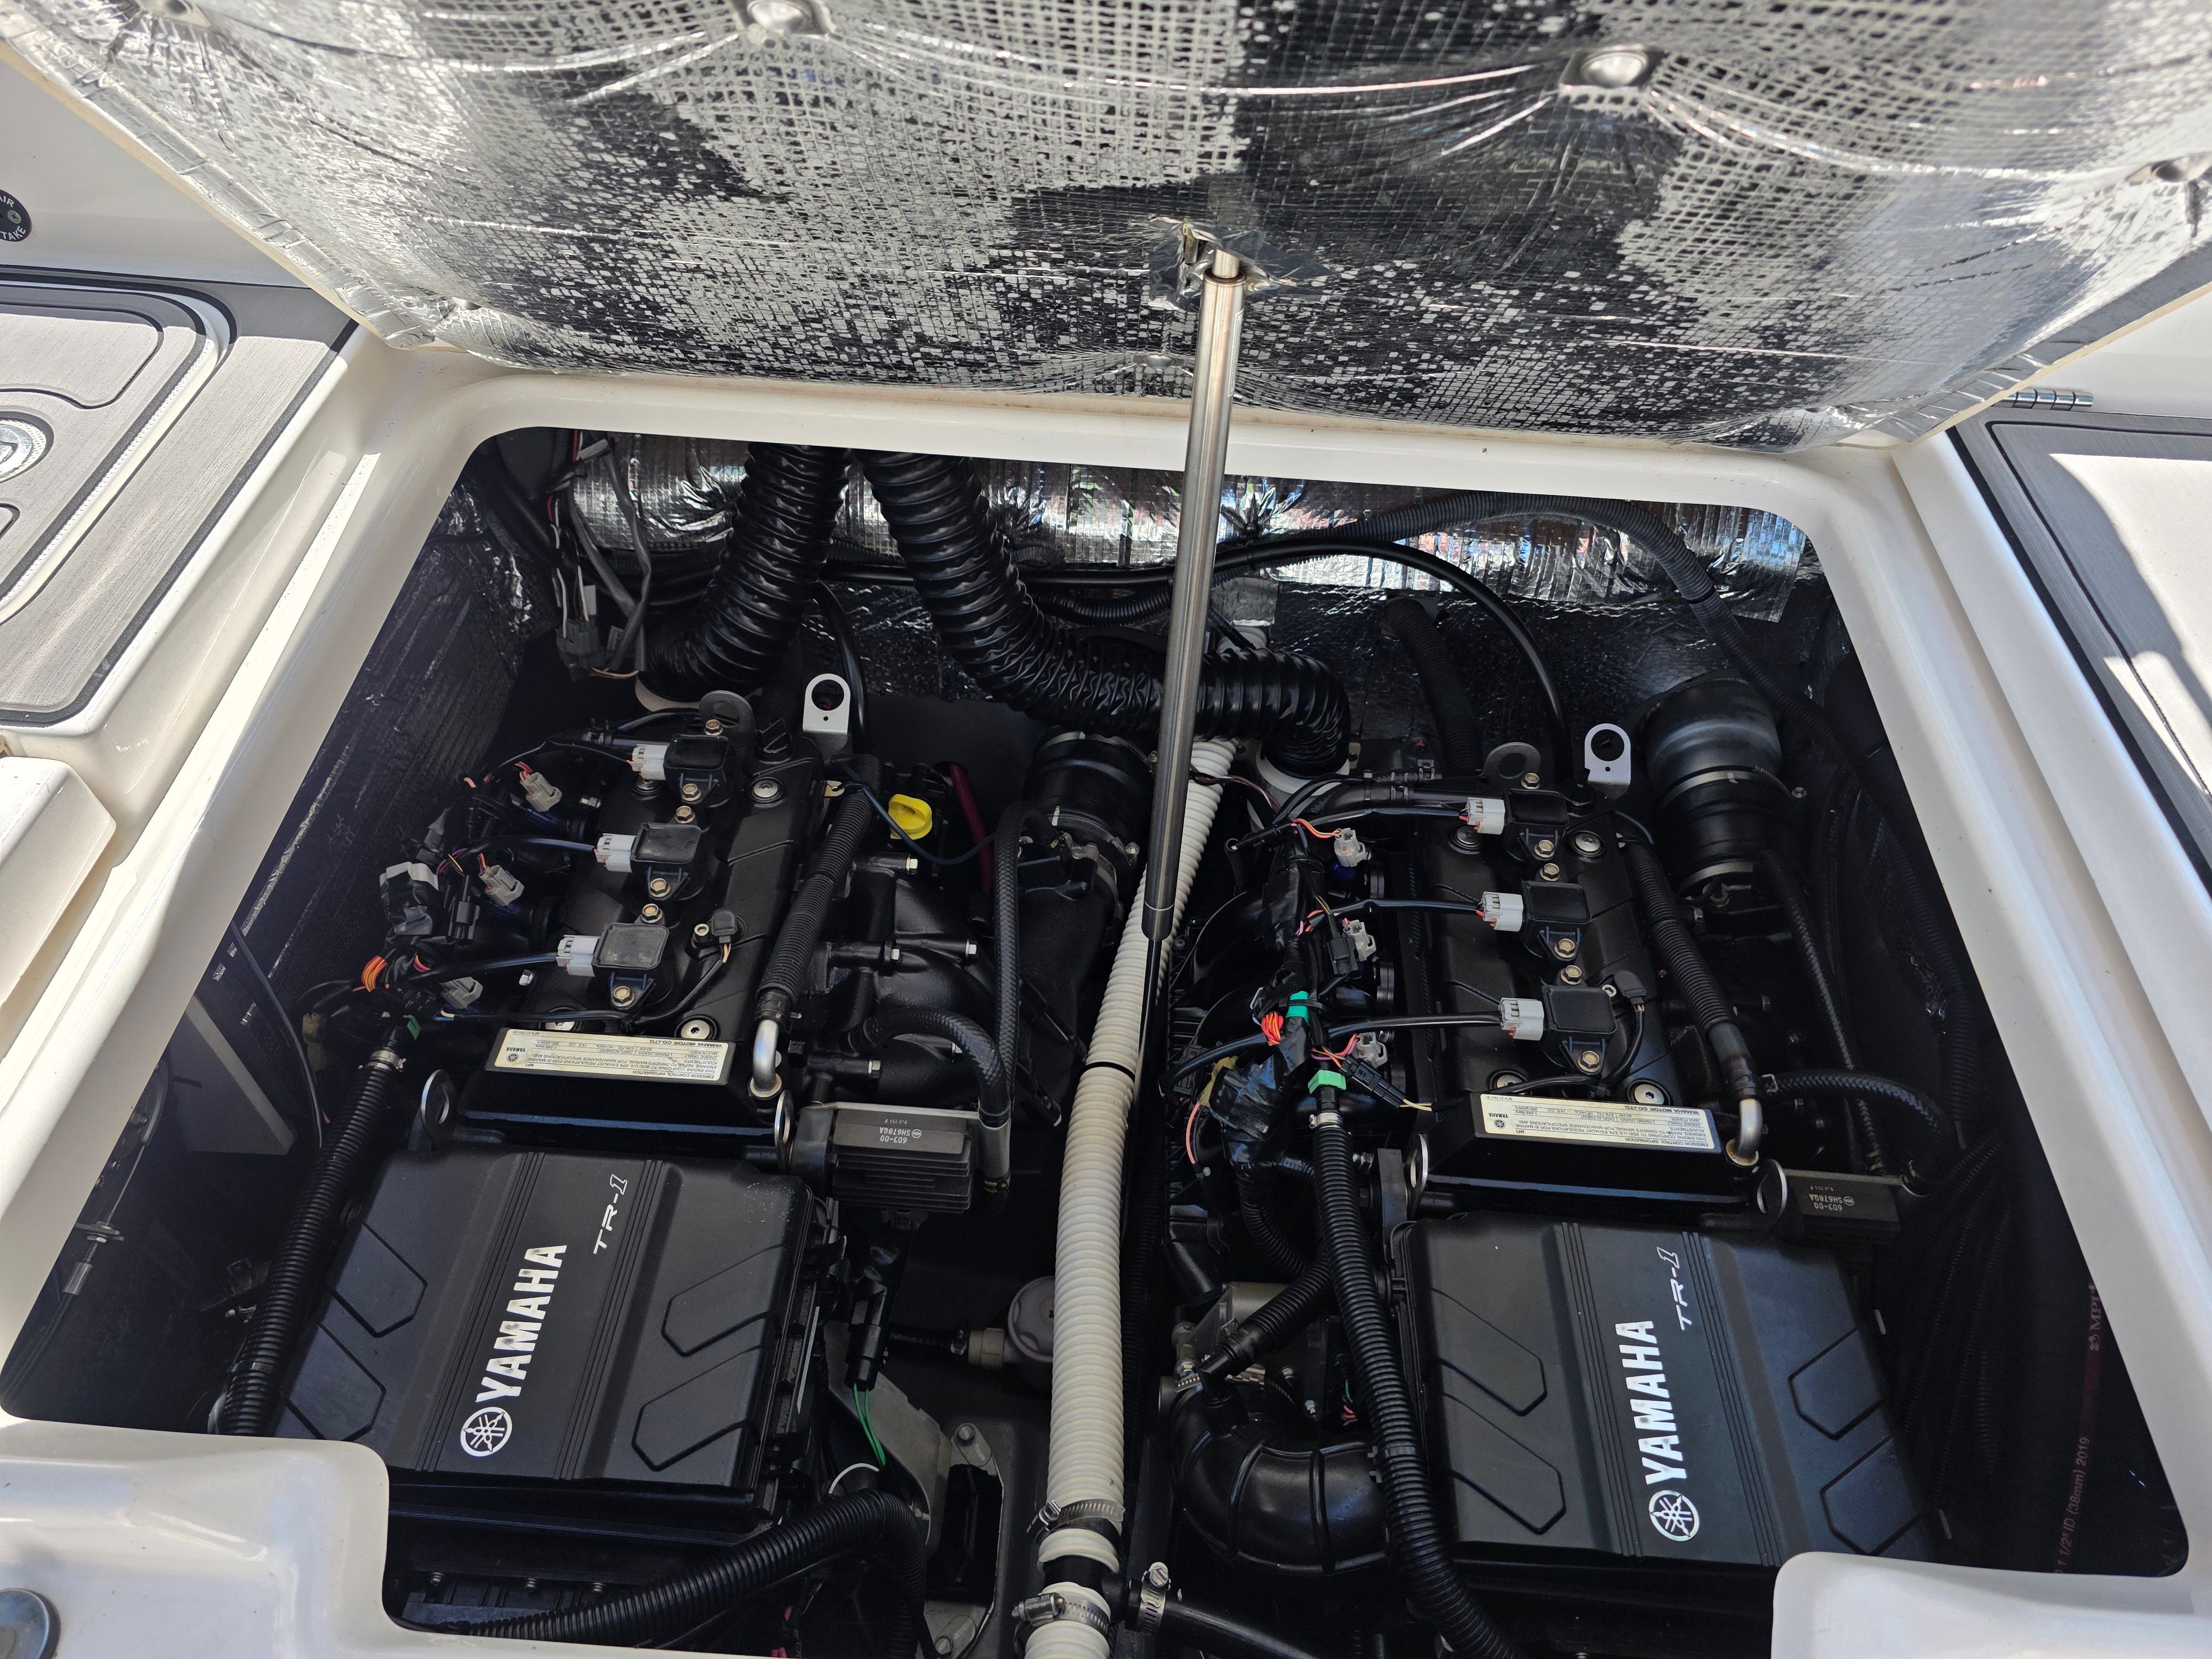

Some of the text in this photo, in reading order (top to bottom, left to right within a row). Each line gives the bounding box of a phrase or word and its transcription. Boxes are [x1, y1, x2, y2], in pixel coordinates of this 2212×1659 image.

[593, 1173, 627, 1254] TR-1
[476, 1244, 567, 1402] YAMAHA
[1656, 1248, 1693, 1331] TR-1
[1615, 1319, 1688, 1485] YAMAHA
[2066, 1469, 2086, 1515] (38mm)
[2075, 1437, 2090, 1467] 2019
[2064, 1517, 2075, 1532] ID
